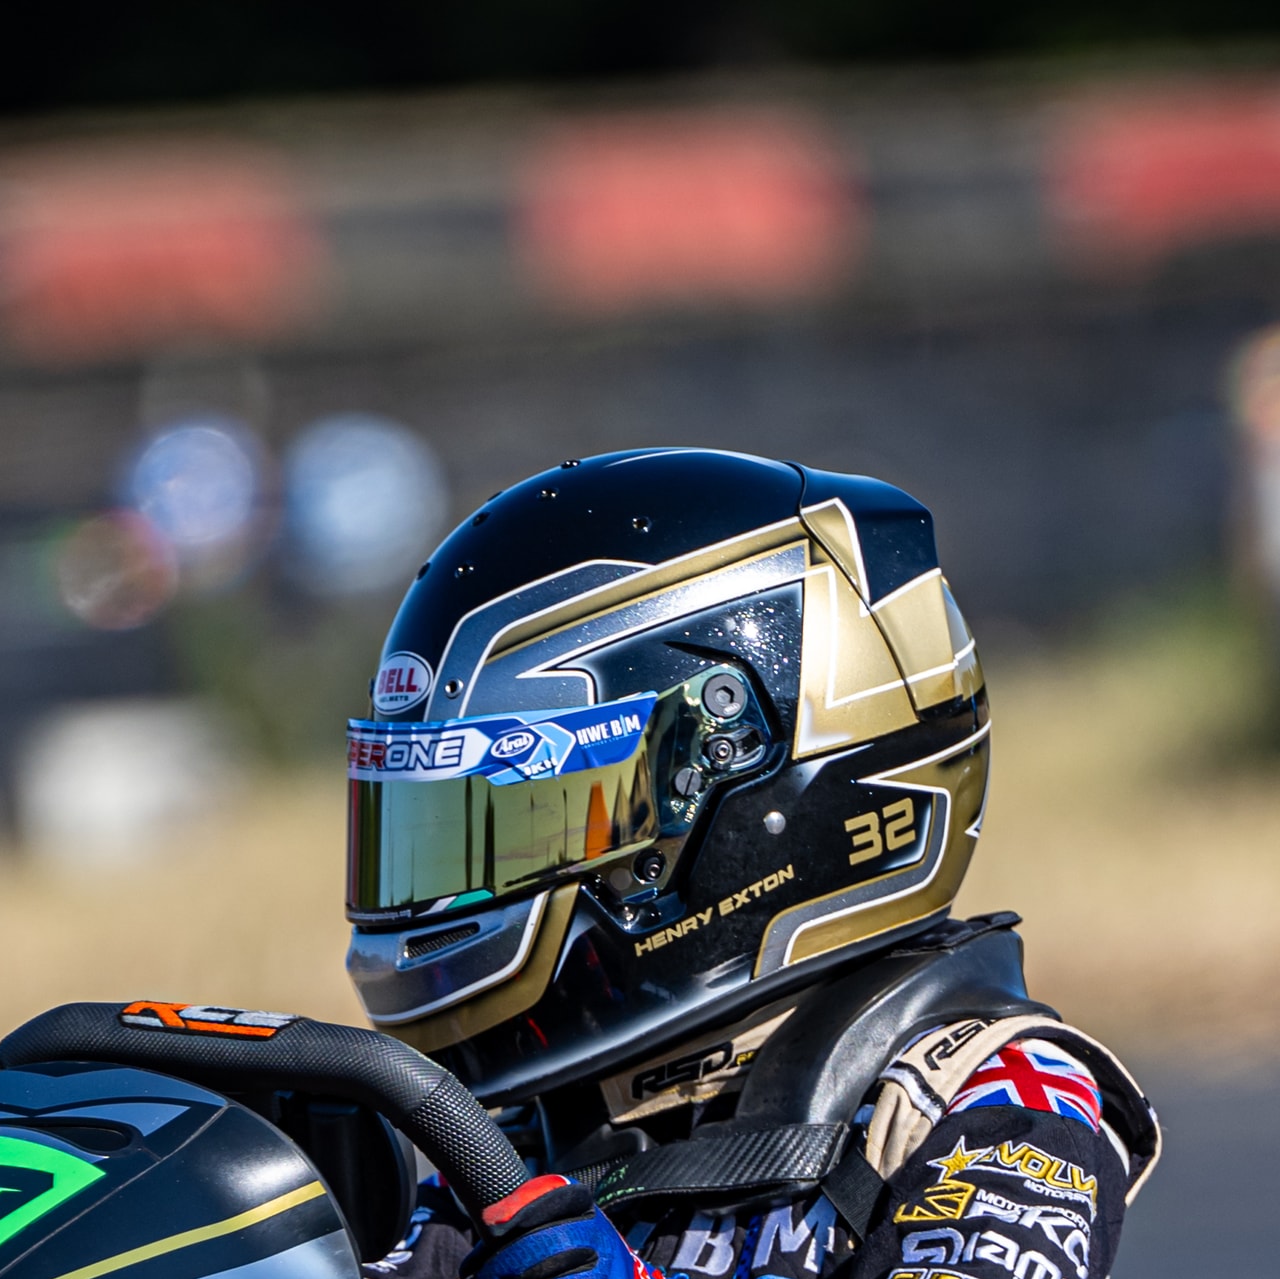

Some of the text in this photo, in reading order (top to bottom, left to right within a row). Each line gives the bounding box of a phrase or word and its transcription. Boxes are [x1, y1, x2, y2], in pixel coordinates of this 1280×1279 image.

[377, 667, 418, 695] BELL
[576, 722, 611, 746] HWE
[843, 797, 917, 866] 32
[633, 863, 795, 957] HENRY EXTON
[923, 1017, 997, 1071] RS
